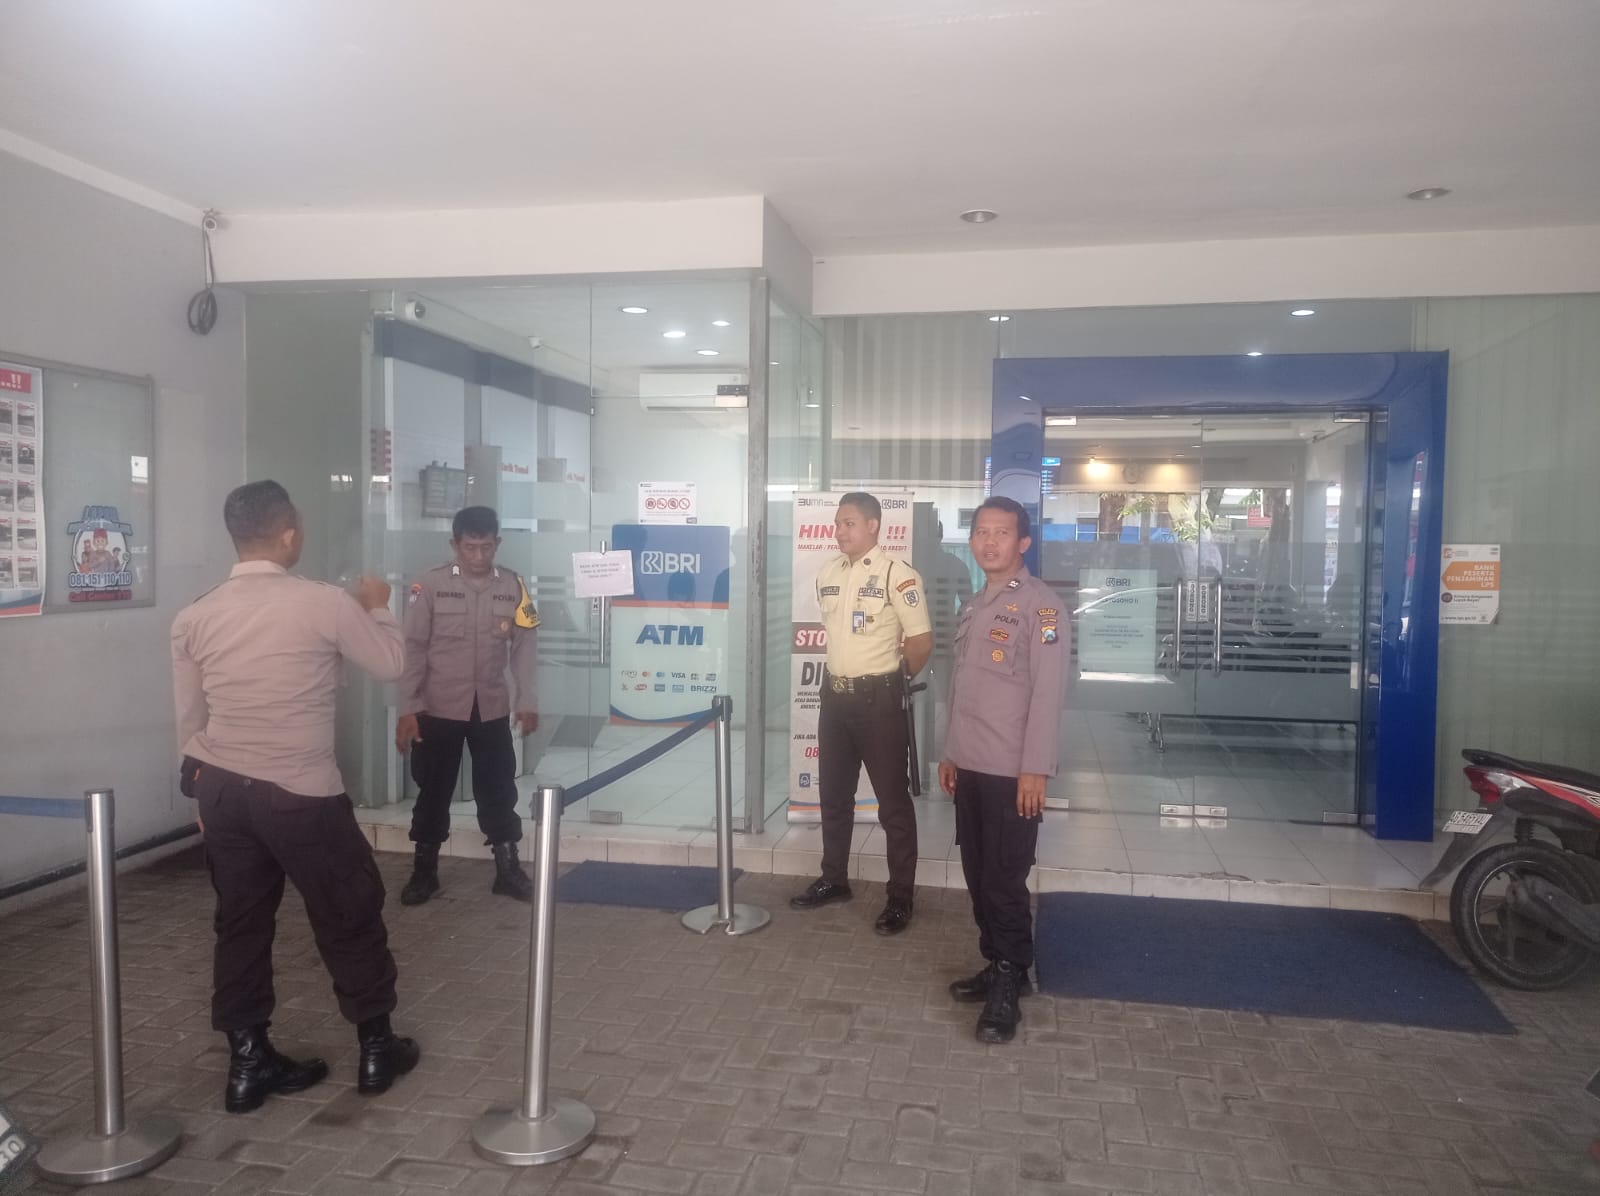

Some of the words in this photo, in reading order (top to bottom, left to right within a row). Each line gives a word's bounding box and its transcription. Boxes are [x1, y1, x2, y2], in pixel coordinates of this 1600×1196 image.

[892, 500, 908, 509] BRI
[799, 525, 835, 538] HIN
[664, 553, 701, 574] BRI
[70, 574, 86, 586] 081
[88, 574, 100, 585] 151
[103, 573, 117, 585] 110
[119, 572, 131, 585] 110
[1116, 578, 1131, 587] BRI
[994, 614, 1020, 626] POLRI
[636, 624, 704, 646] ATM
[795, 630, 827, 647] STO
[671, 672, 686, 680] VISA
[801, 662, 822, 686] DI
[690, 685, 717, 694] BRIZZI
[805, 747, 820, 758] 08
